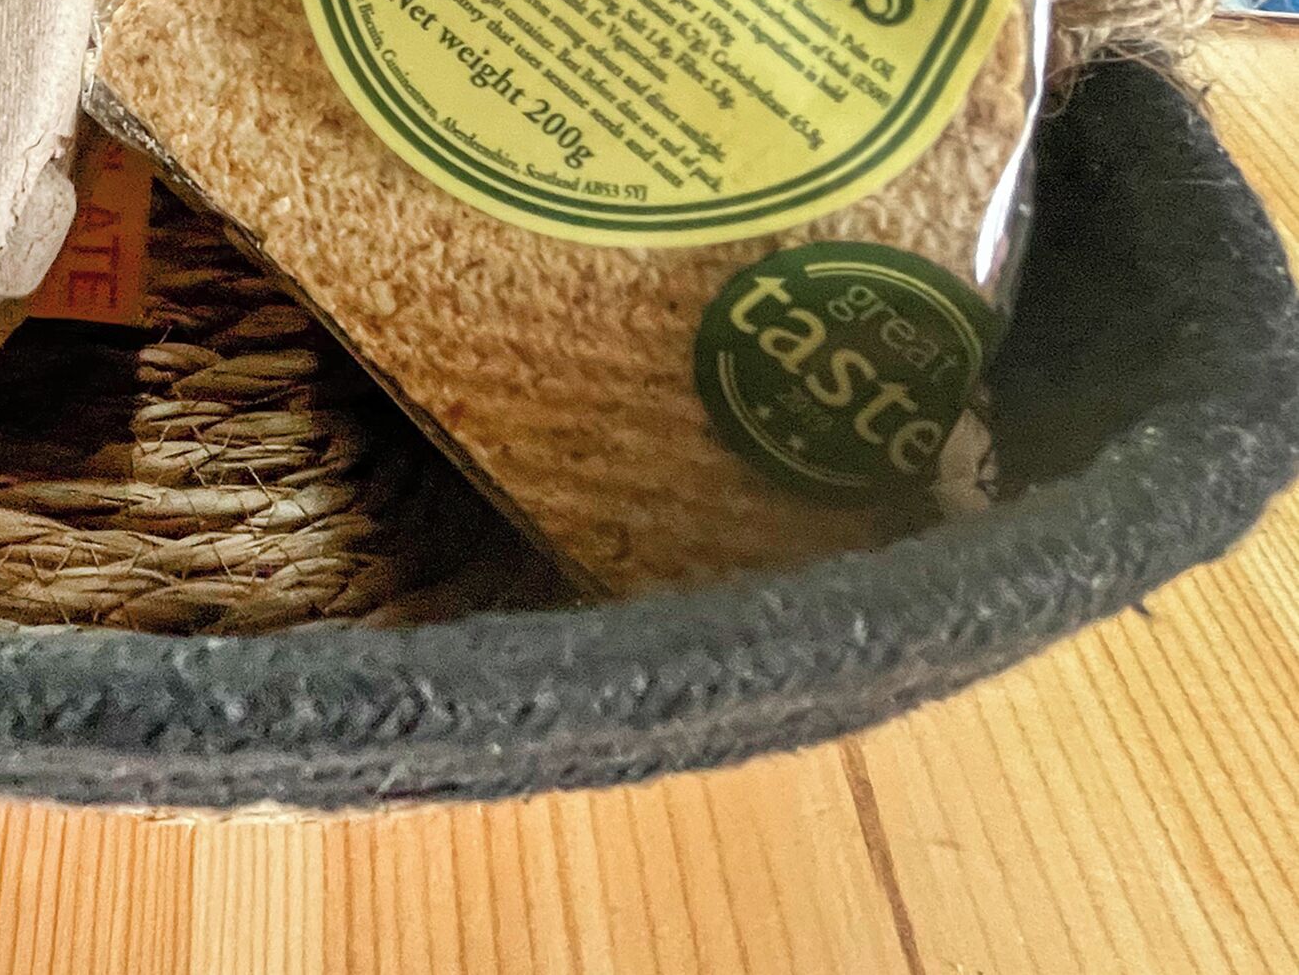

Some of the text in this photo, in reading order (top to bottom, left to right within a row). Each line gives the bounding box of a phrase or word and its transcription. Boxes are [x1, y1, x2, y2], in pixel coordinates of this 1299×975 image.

[585, 9, 606, 29] for
[485, 19, 515, 46] that
[513, 43, 543, 70] uses
[541, 68, 589, 109] sesame
[588, 107, 625, 139] seeds
[623, 138, 657, 162] and
[555, 46, 582, 74] Best
[621, 75, 651, 96] and
[437, 25, 527, 106] weight
[523, 97, 595, 169] 200g
[523, 162, 579, 192] Scotland
[828, 284, 958, 381] great
[730, 277, 943, 472] taste
